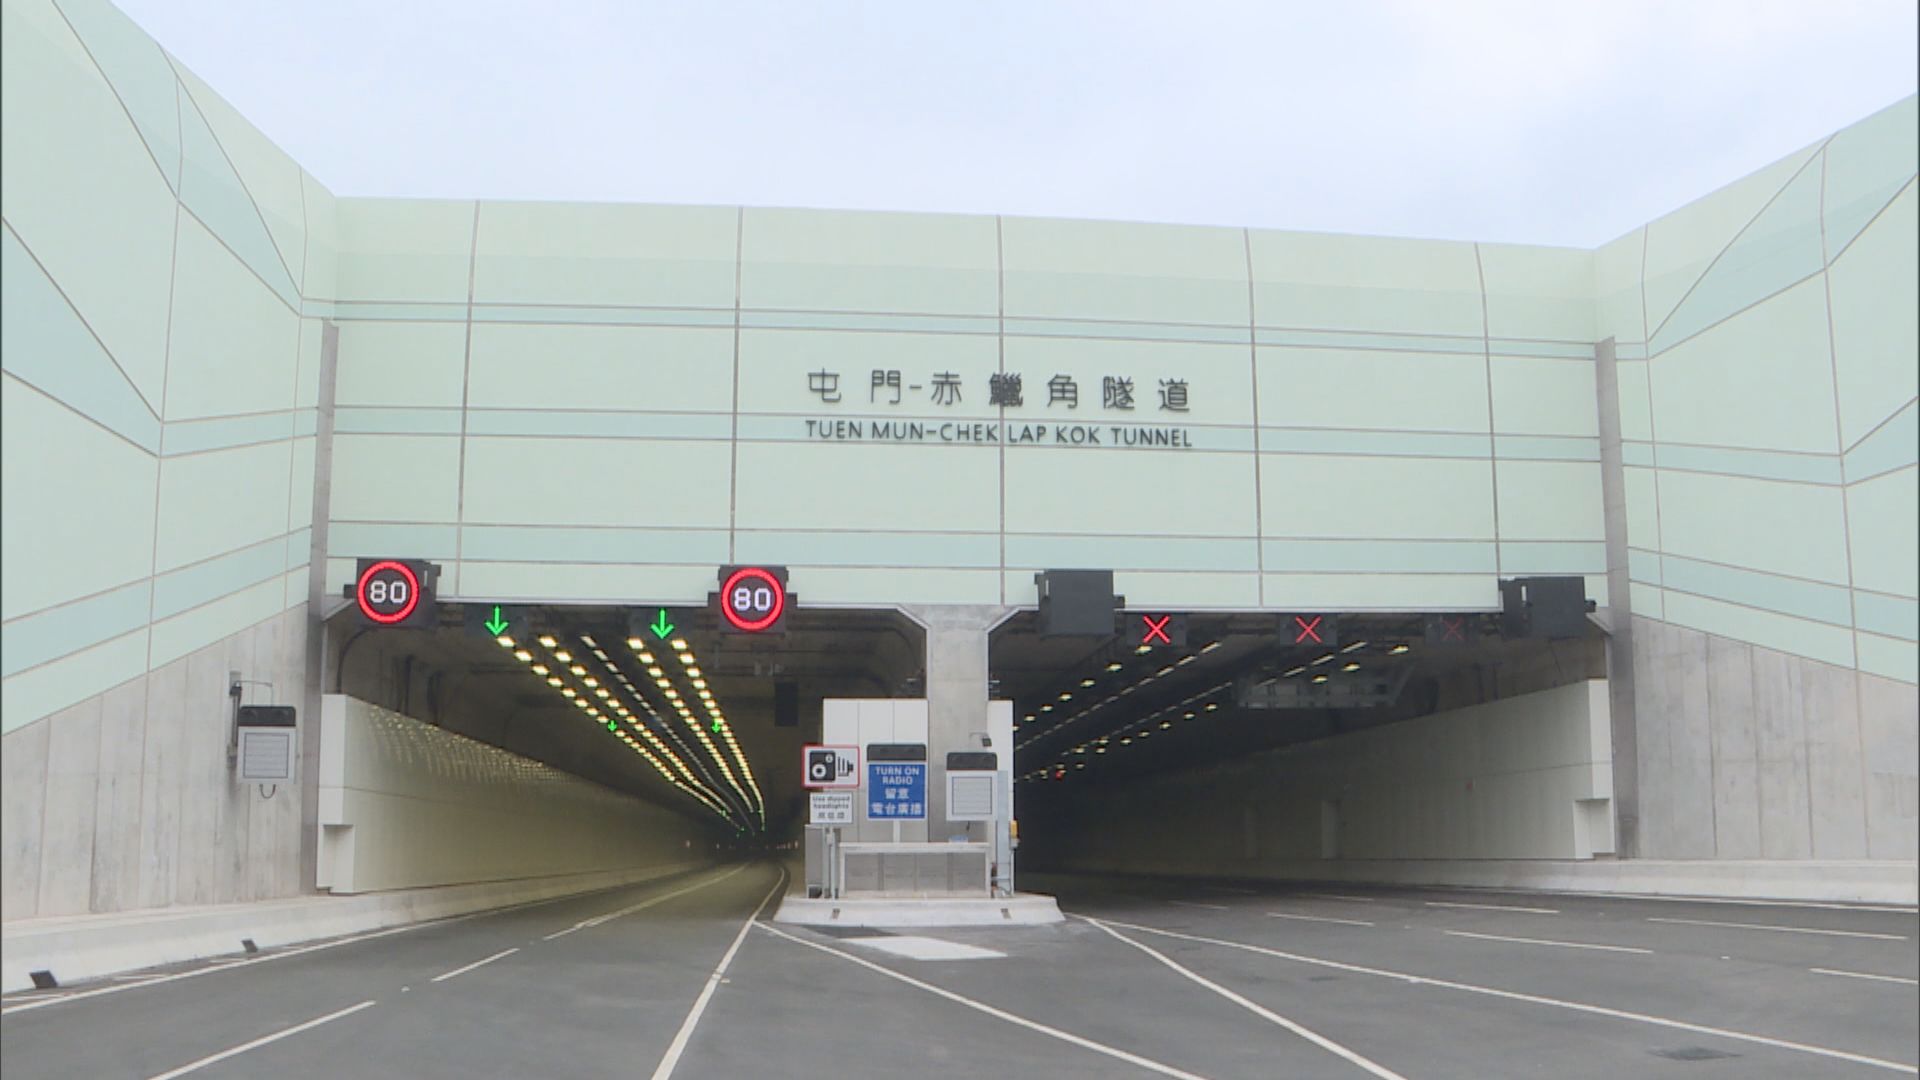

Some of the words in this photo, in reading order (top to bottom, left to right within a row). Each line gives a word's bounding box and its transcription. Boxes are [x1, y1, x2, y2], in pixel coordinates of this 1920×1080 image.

[805, 420, 862, 438] TUEN
[871, 421, 998, 441] MUN-CHEK
[1008, 424, 1047, 443] LAP
[1055, 426, 1100, 444] KOK
[1111, 428, 1192, 447] TUNNEL
[369, 580, 407, 603] 80
[734, 587, 771, 611] 80
[875, 766, 902, 775] TURN
[904, 766, 920, 775] ON
[882, 776, 913, 785] RADIO
